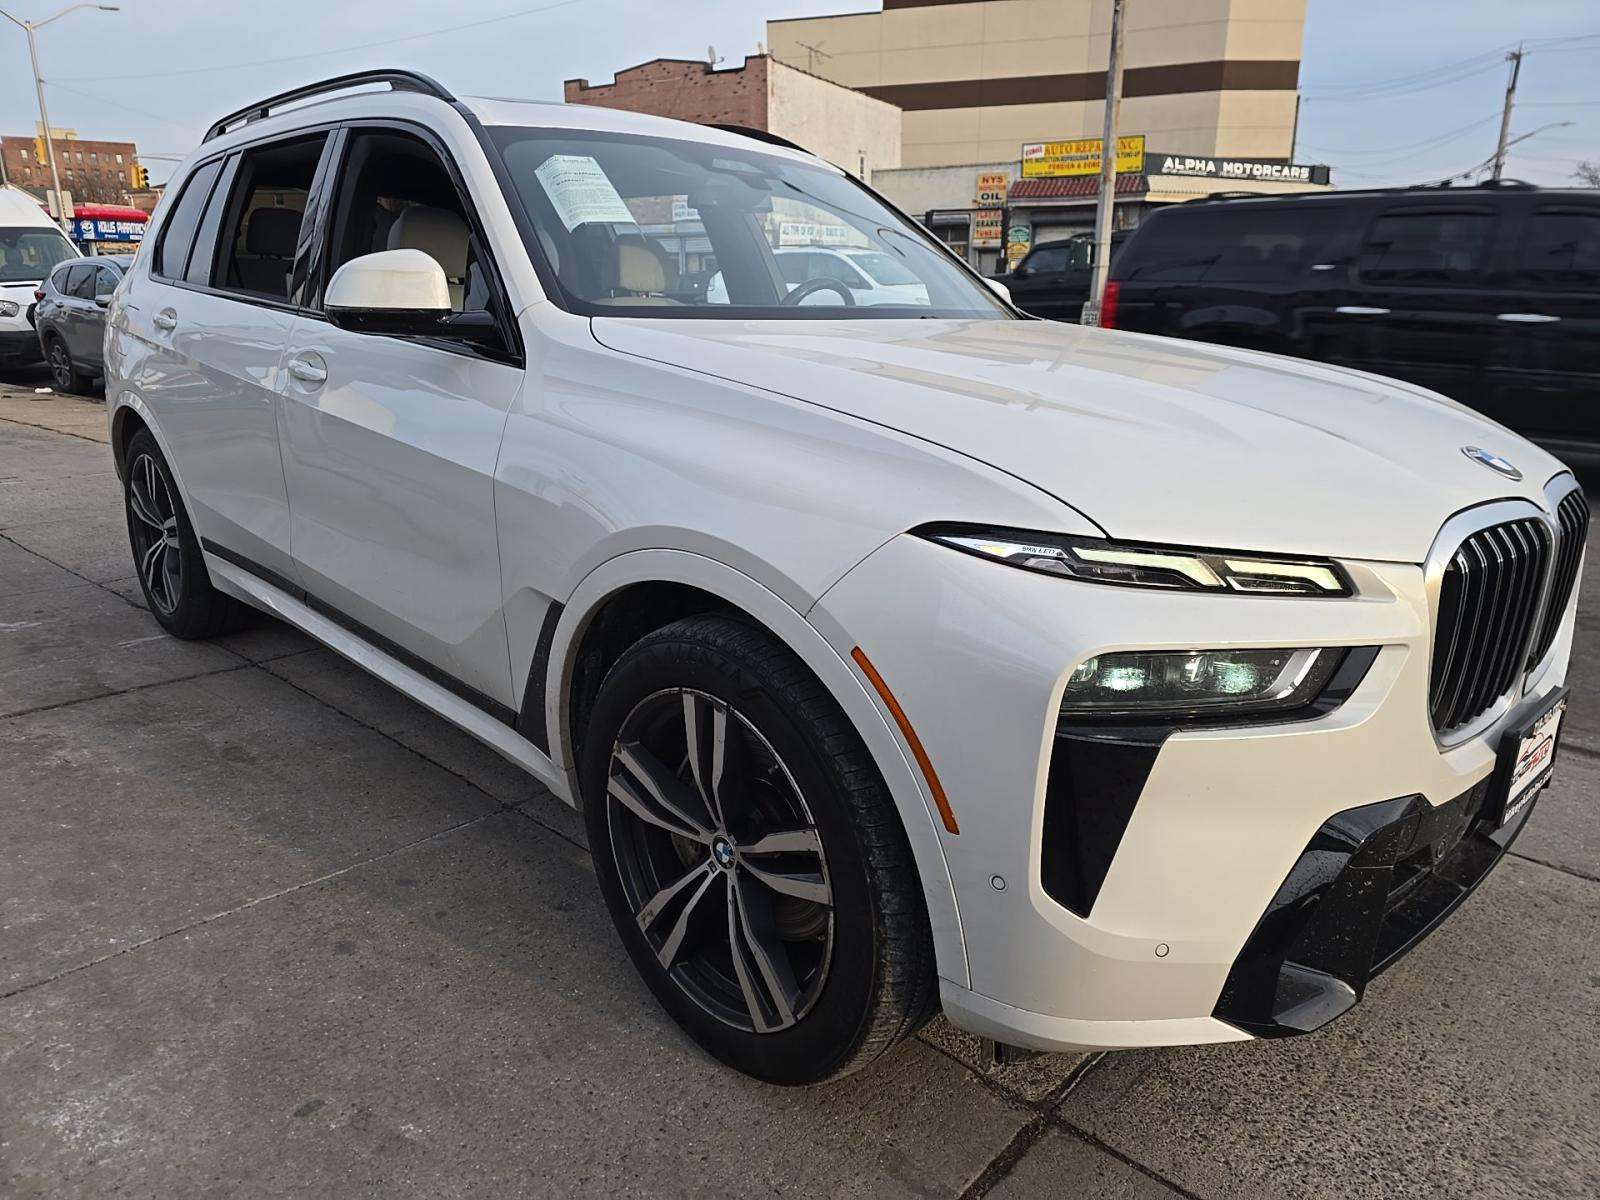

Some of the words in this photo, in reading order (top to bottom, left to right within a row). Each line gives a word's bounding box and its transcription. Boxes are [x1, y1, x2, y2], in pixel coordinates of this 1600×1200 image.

[1044, 142, 1073, 156] AUTO
[1162, 156, 1217, 173] ALPHA
[1222, 161, 1311, 180] MOTORCARS
[981, 175, 1004, 184] NYS
[980, 192, 1003, 201] OIL
